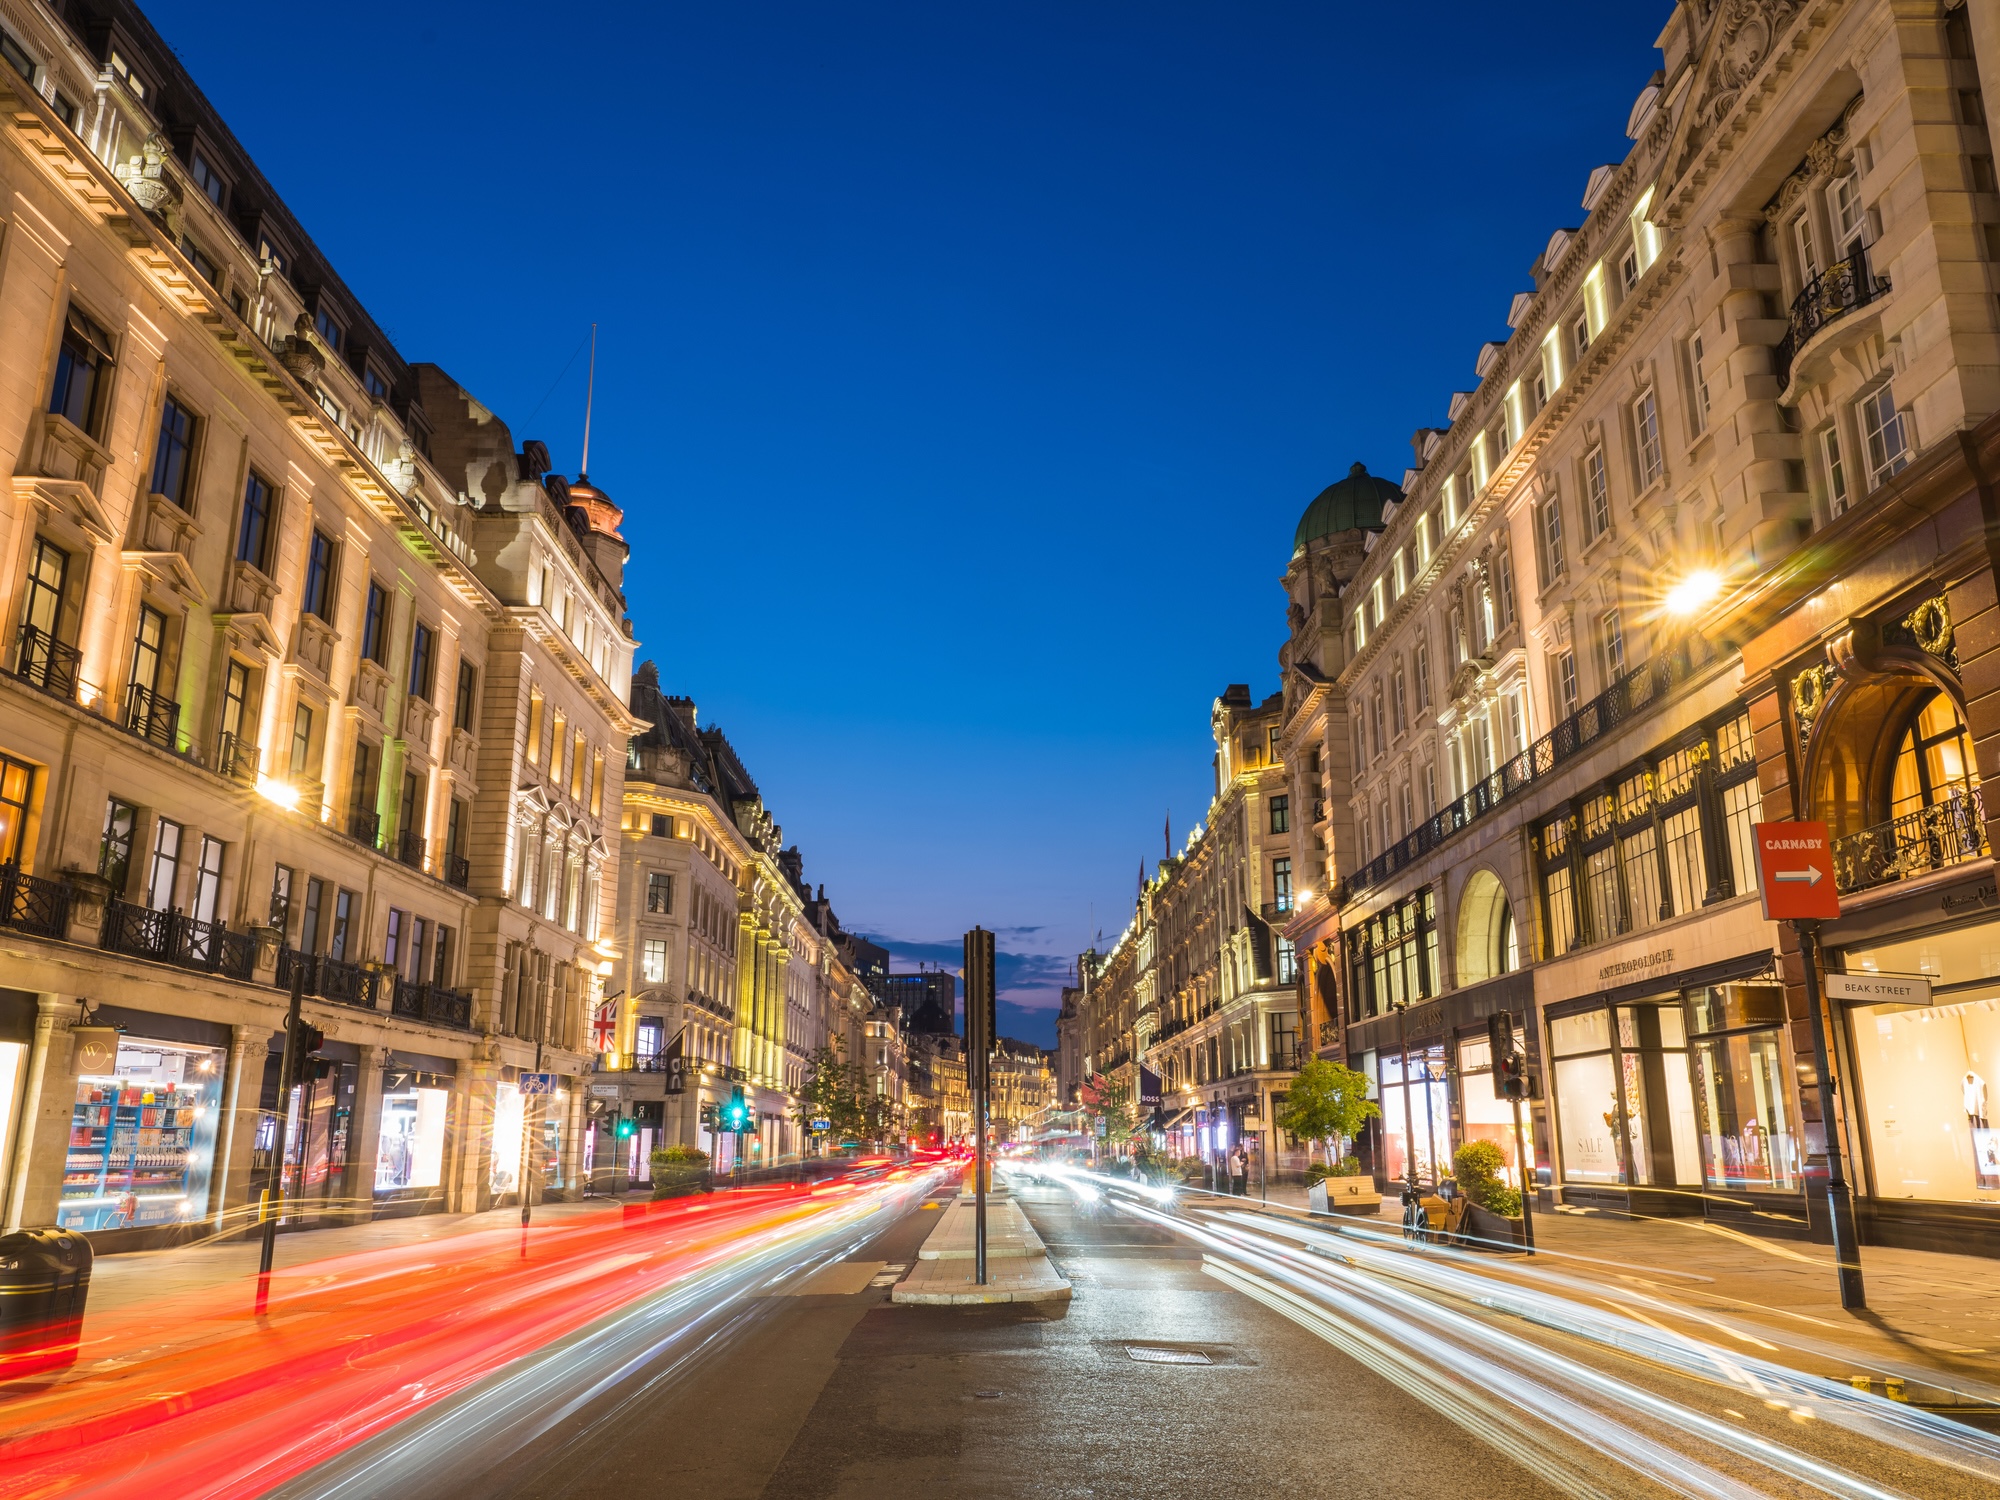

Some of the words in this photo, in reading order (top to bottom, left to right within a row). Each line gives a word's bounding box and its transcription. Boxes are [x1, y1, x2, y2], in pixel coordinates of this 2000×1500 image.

[1765, 838, 1823, 850] CARNABY
[1599, 949, 1675, 980] ANTHROPOLOGIE
[1844, 983, 1871, 993] BEAK
[1874, 985, 1912, 996] STREET
[1417, 1006, 1443, 1027] GUESS
[1578, 1138, 1603, 1152] SALE
